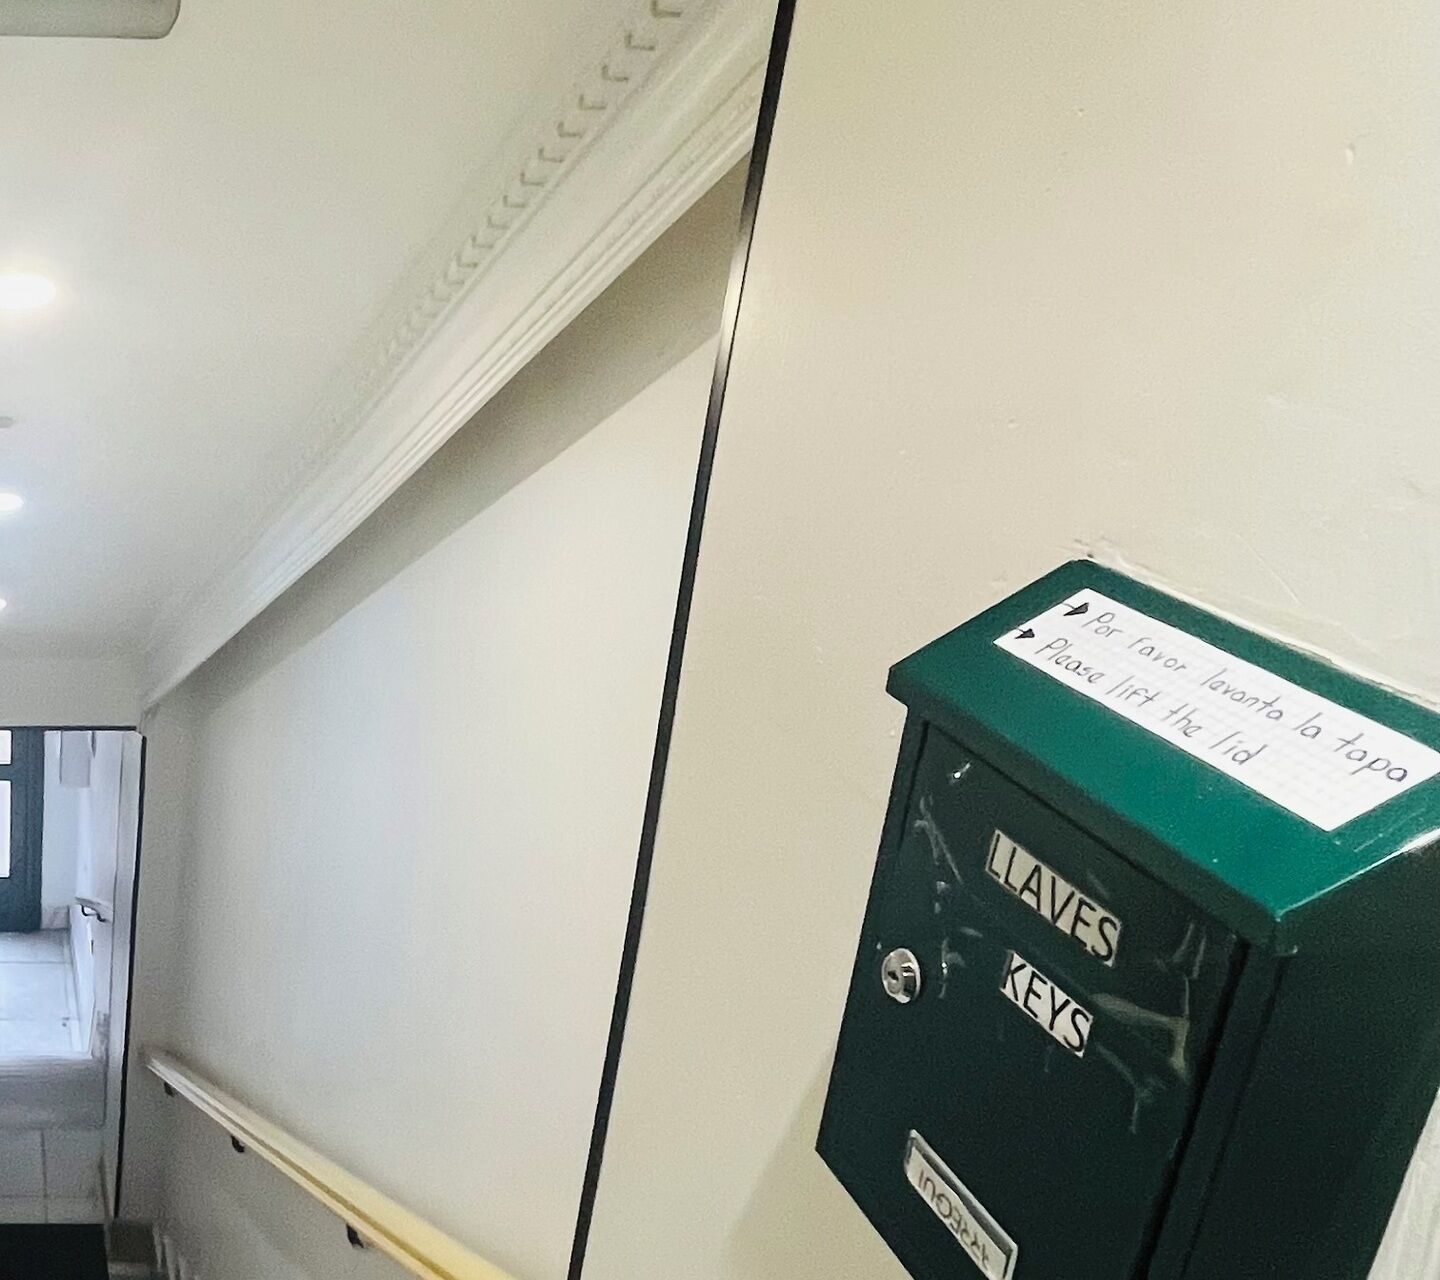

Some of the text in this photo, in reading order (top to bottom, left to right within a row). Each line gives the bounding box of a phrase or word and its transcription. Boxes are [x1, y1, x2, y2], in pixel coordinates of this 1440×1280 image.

[1034, 637, 1269, 766] Please lift the lid
[1081, 611, 1123, 638] Por
[1127, 636, 1188, 672] favor
[1292, 711, 1323, 740] la
[1334, 732, 1409, 783] tapa
[988, 832, 1119, 963] LLAVES
[1002, 951, 1091, 1053] KEYS
